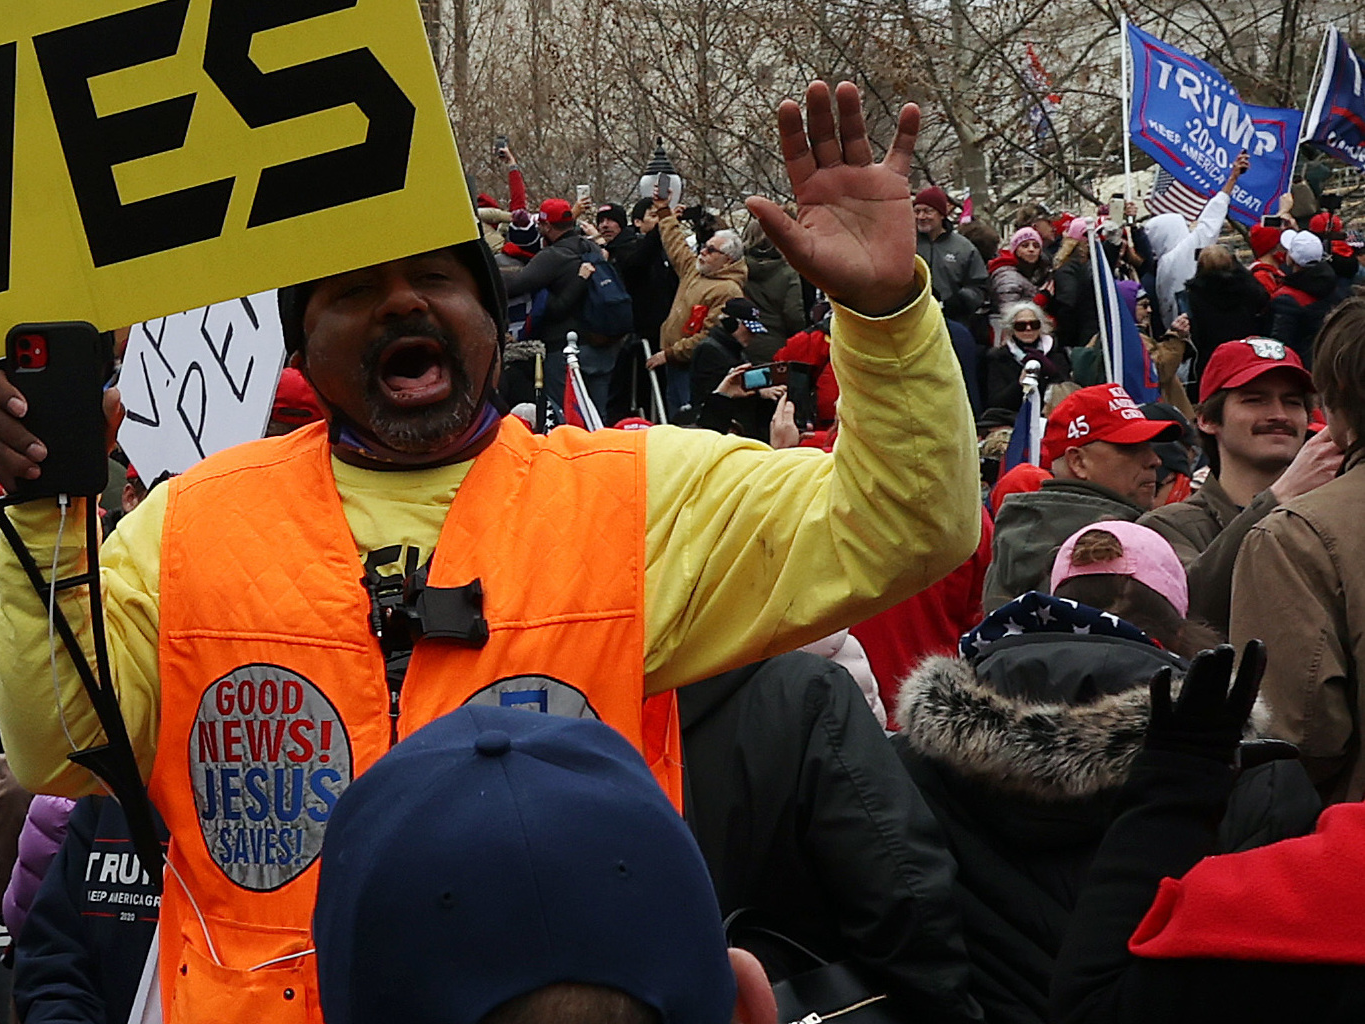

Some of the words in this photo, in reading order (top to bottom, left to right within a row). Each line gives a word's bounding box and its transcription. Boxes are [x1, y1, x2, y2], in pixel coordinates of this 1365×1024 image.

[1157, 60, 1277, 157] TRUMP
[1148, 119, 1182, 145] KEEP
[1181, 141, 1227, 186] AMERICA
[1230, 187, 1264, 213] REAT!
[1188, 118, 1229, 169] 2020
[1067, 415, 1090, 439] 45
[216, 679, 304, 716] GOOD
[198, 719, 333, 763] NEWS!
[202, 767, 342, 822] JESUS
[219, 827, 304, 865] SAVES!
